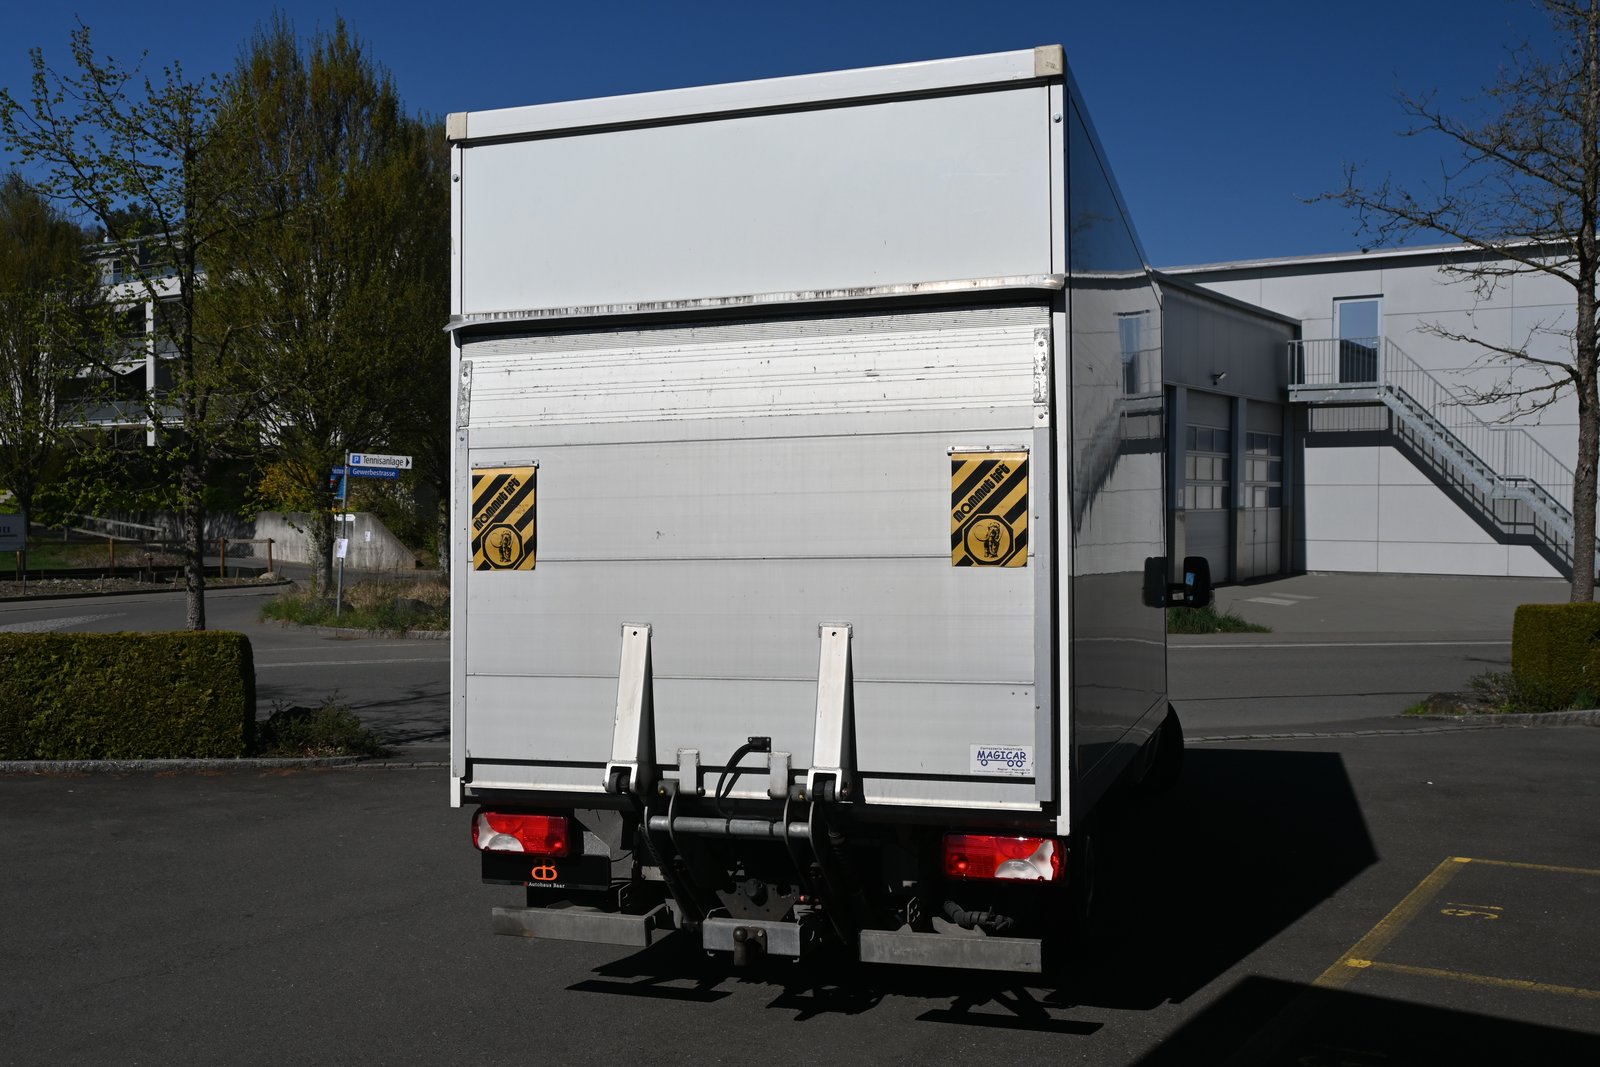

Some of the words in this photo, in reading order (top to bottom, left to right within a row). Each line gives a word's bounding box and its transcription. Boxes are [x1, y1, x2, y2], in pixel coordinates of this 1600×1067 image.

[363, 455, 404, 467] Tennisanlage
[352, 468, 396, 477] Gewerbestrasse
[977, 750, 1026, 760] MAGICAR
